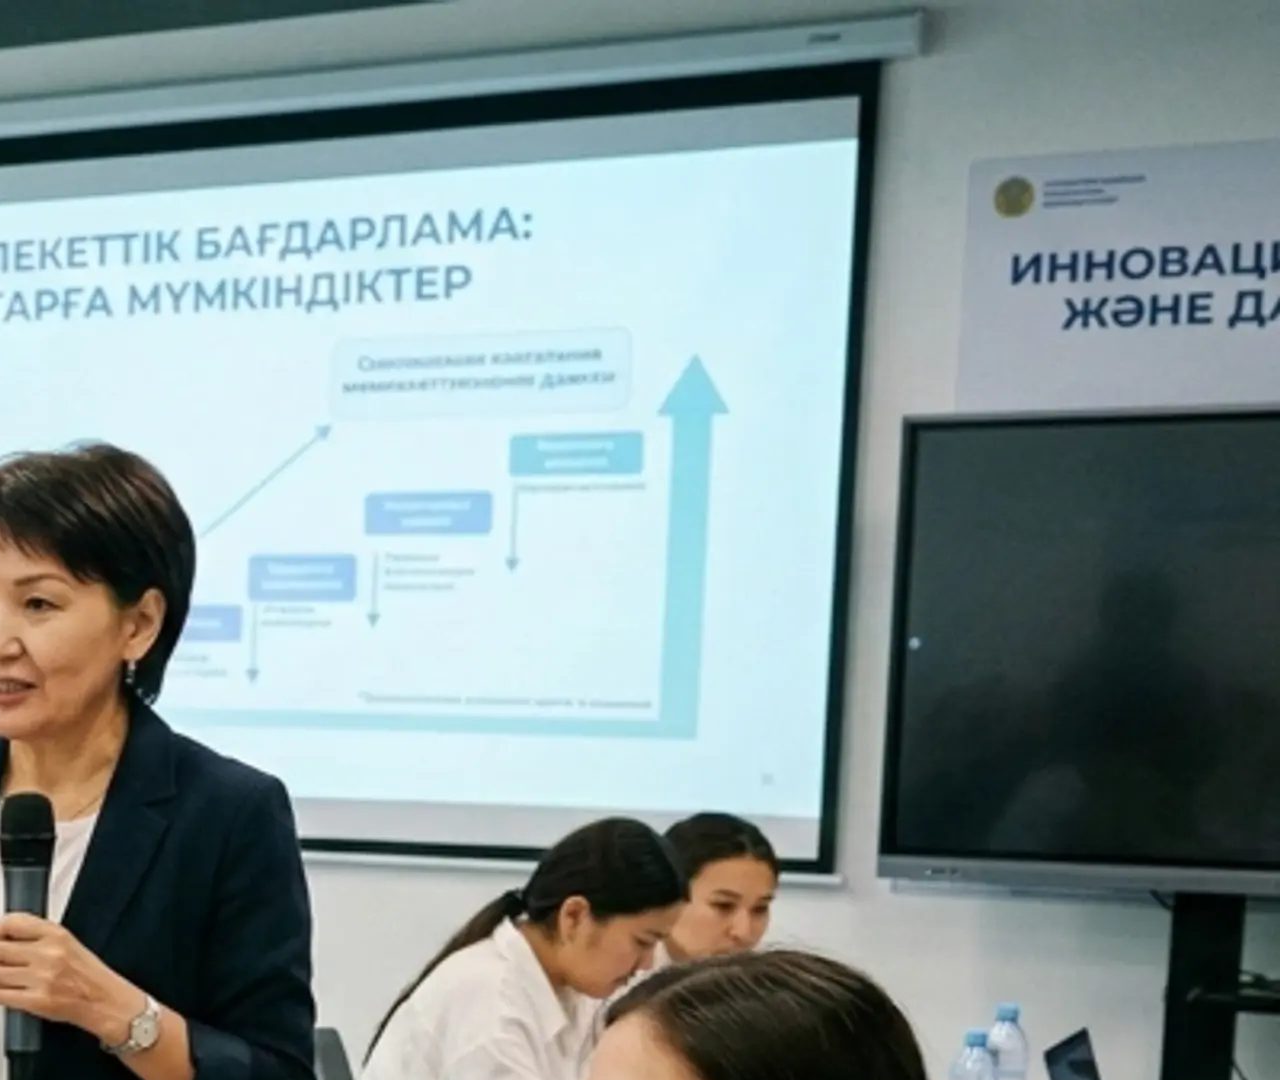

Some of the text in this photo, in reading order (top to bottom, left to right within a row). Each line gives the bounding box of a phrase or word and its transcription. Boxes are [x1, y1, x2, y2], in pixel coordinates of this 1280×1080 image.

[195, 206, 534, 262] БАҒДАРЛАМА:
[127, 264, 473, 316] МҮМКІНДІКТЕР
[1062, 291, 1214, 331] ЖӘНЕ
